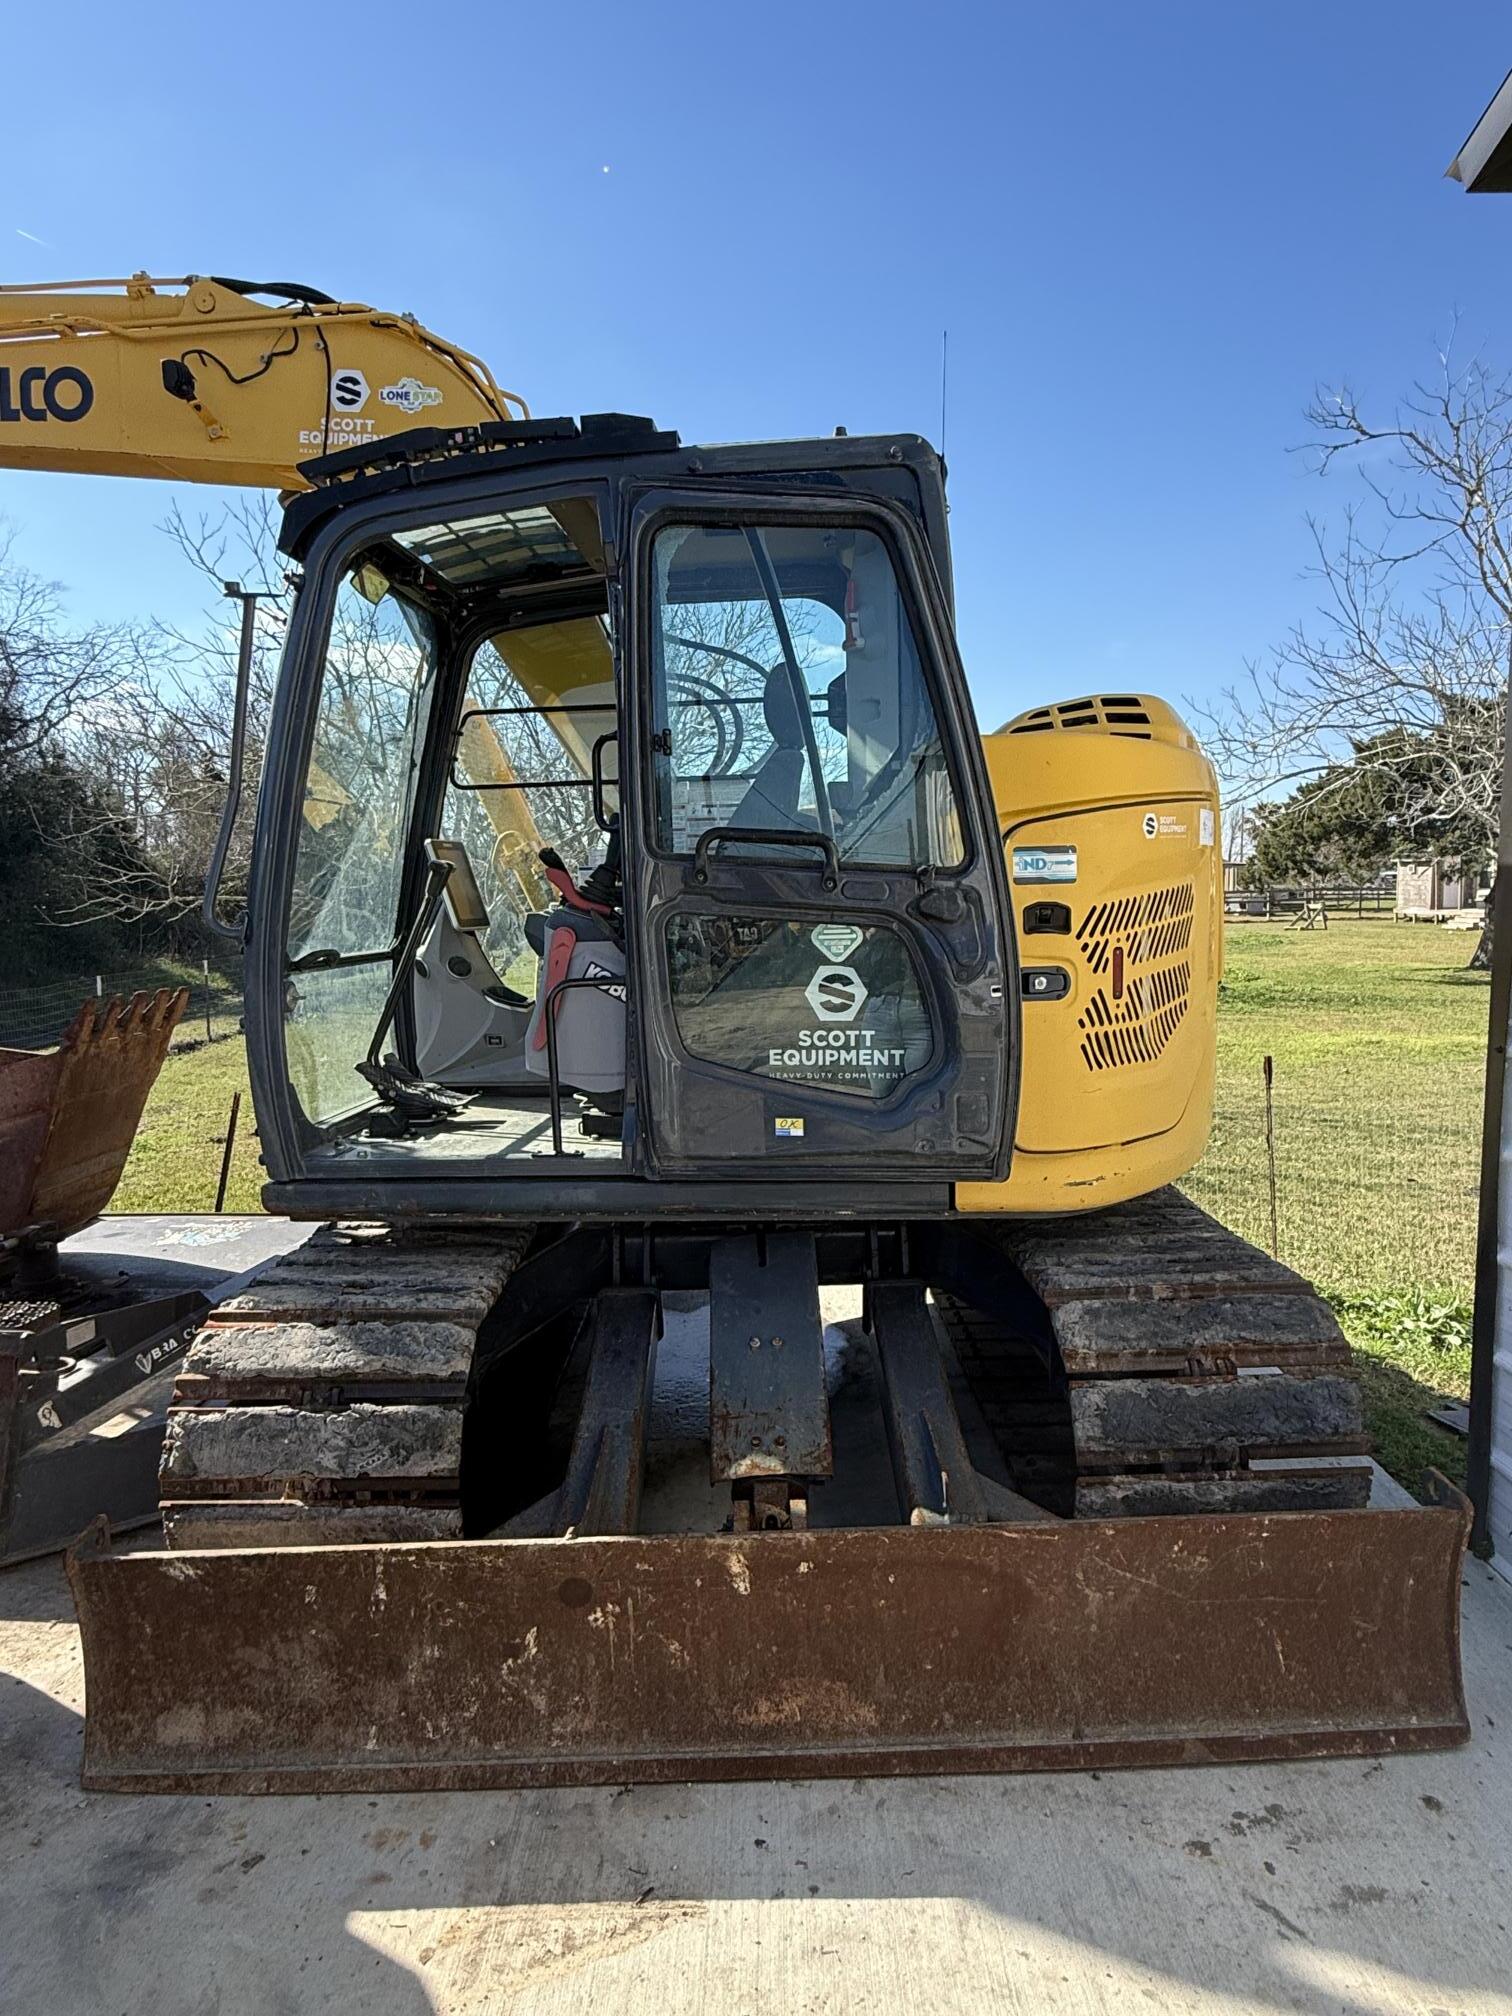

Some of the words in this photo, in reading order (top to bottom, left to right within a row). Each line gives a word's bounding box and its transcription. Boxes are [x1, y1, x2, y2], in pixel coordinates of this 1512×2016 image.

[0, 366, 94, 422] LCO
[380, 390, 411, 401] LONE
[320, 418, 375, 432] SCOTT
[299, 431, 391, 446] EQUIPME
[798, 1030, 875, 1047] SCOTT
[769, 1049, 905, 1066] EQUIPMENT
